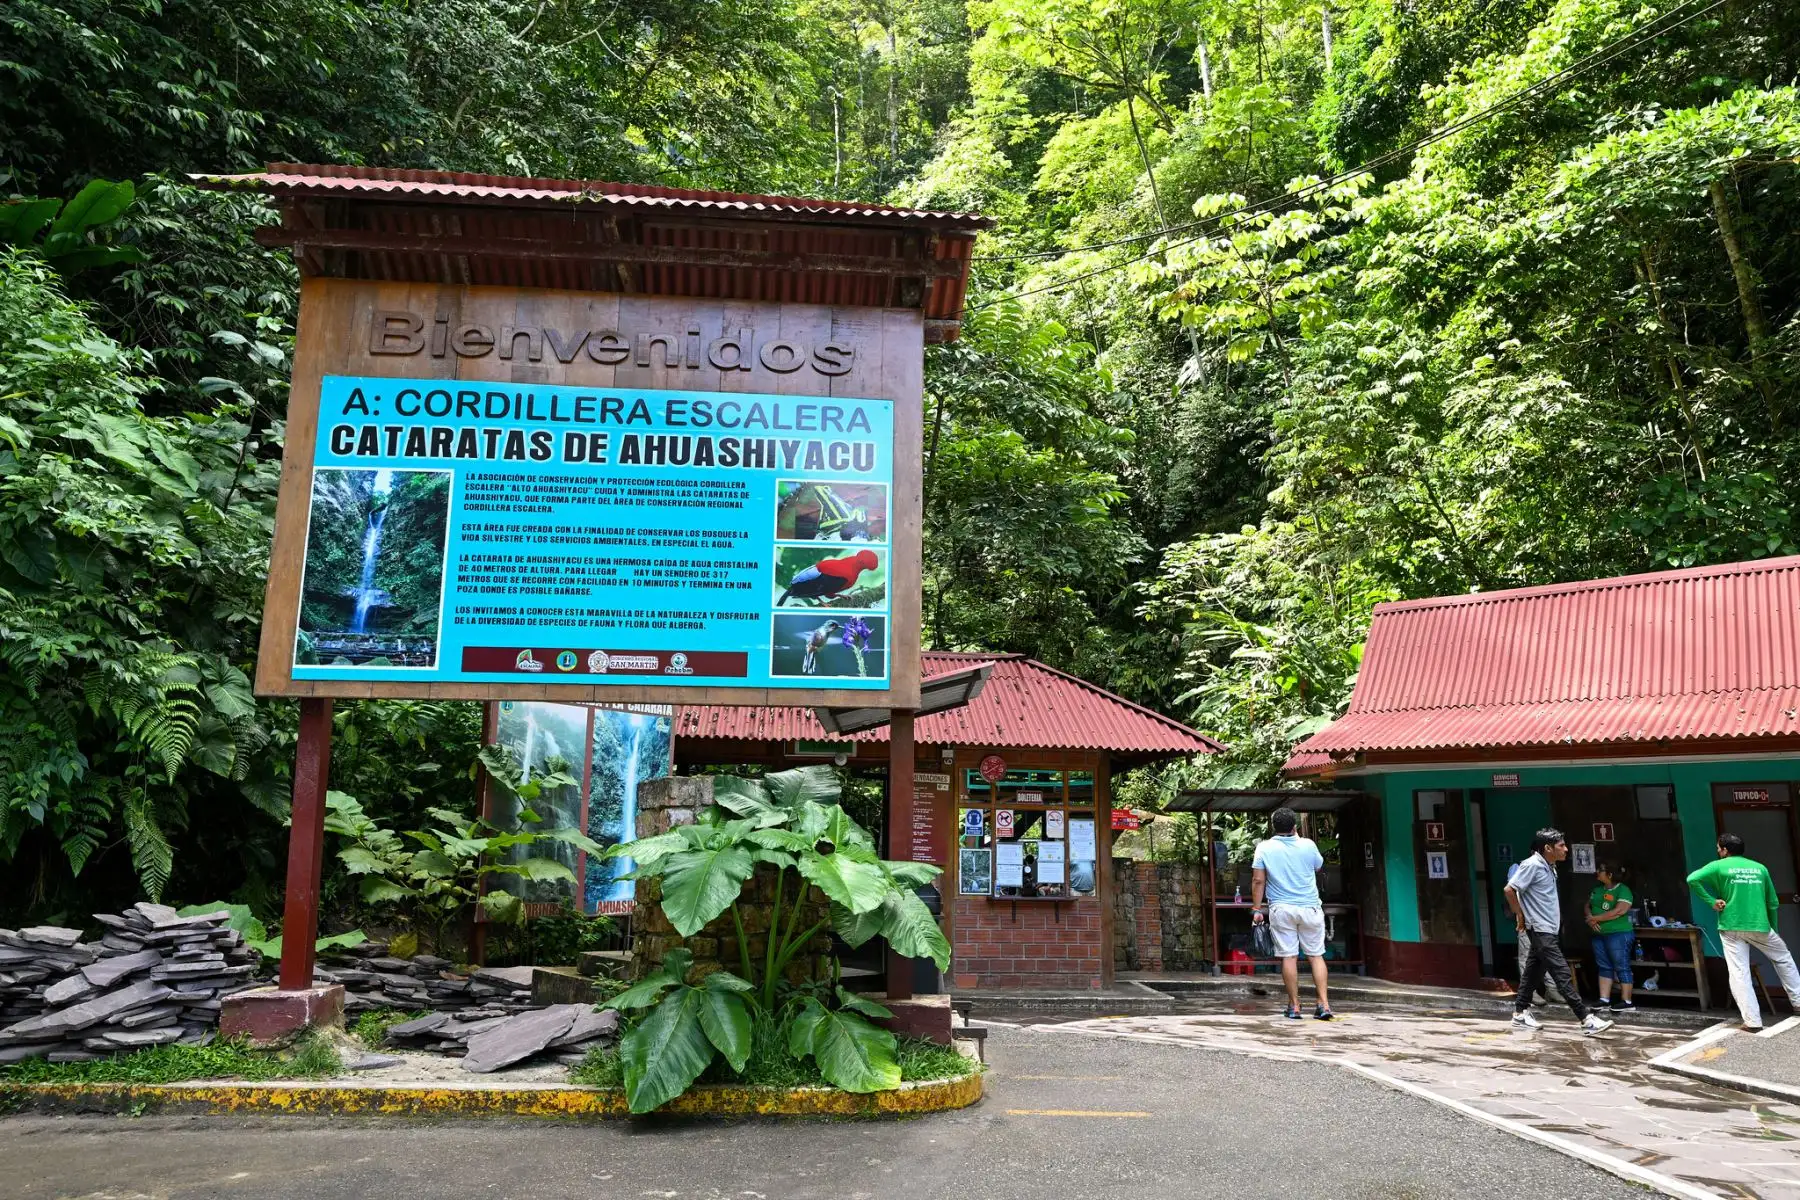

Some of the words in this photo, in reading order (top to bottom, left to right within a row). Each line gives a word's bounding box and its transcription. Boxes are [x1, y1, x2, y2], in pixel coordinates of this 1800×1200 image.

[369, 310, 856, 376] Bienvenidos
[342, 387, 381, 416] A:
[395, 388, 652, 426] CORDILLERA
[665, 399, 872, 434] ESCALERA
[331, 424, 553, 460] CATARATAS
[564, 433, 607, 463] DE
[619, 434, 874, 472] AHUASHIYACU
[477, 473, 525, 482] ASOCIACIÓN
[539, 476, 598, 484] CONSERVACIÓN
[607, 478, 655, 486] PROTECCIÓN
[656, 479, 698, 487] ECOLÓGICA
[700, 480, 746, 489] CORDILLERA
[465, 483, 504, 491] ESCALERA
[627, 488, 675, 497] ADMINISTRA
[693, 490, 738, 498] CATARATAS
[464, 503, 511, 512] CORDILLERA
[541, 496, 569, 504] FORMA
[571, 496, 596, 504] PARTE
[614, 497, 633, 506] ÁREA
[647, 499, 706, 508] CONSERVACIÓN
[707, 500, 743, 508] REGIONAL
[484, 523, 504, 532] ÁREA
[522, 525, 553, 533] CREADA
[584, 526, 624, 535] FINALIDAD
[637, 528, 683, 537] CONSERVAR
[702, 530, 737, 538] BOSQUES
[482, 534, 523, 543] SILVESTRE
[550, 536, 591, 544] SERVICIOS
[663, 539, 699, 547] ESPECIAL
[712, 540, 734, 548] AGUA.
[471, 554, 512, 563] CATARATA
[526, 556, 582, 564] AHUASHIYACU
[613, 558, 651, 566] HERMOSA
[714, 561, 758, 569] CRISTALINA
[483, 565, 516, 573] METROS
[530, 566, 562, 574] ALTURA.
[565, 567, 586, 575] PARA
[664, 570, 699, 578] SENDERO
[458, 574, 491, 583] METROS
[493, 575, 508, 583] QUE
[521, 576, 557, 584] RECORRE
[559, 577, 575, 585] CON
[577, 577, 617, 586] FACILIDAD
[643, 579, 679, 587] MINUTOS
[689, 580, 723, 588] TERMINA
[457, 585, 478, 593] POZA
[480, 586, 506, 594] DONDE
[519, 586, 552, 595] POSIBLE
[554, 586, 592, 596] BAÑARSE.
[473, 606, 517, 615] INVITAMOS
[526, 608, 563, 616] CONOCER
[587, 609, 632, 617] MARAVILLA
[658, 610, 707, 619] NATURALEZA
[717, 612, 759, 620] DISFRUTAR
[478, 617, 525, 626] DIVERSIDAD
[539, 618, 576, 626] ESPECIES
[625, 620, 649, 628] FLORA
[669, 621, 706, 630] ALBERGA.
[1734, 792, 1759, 800] TOPICO
